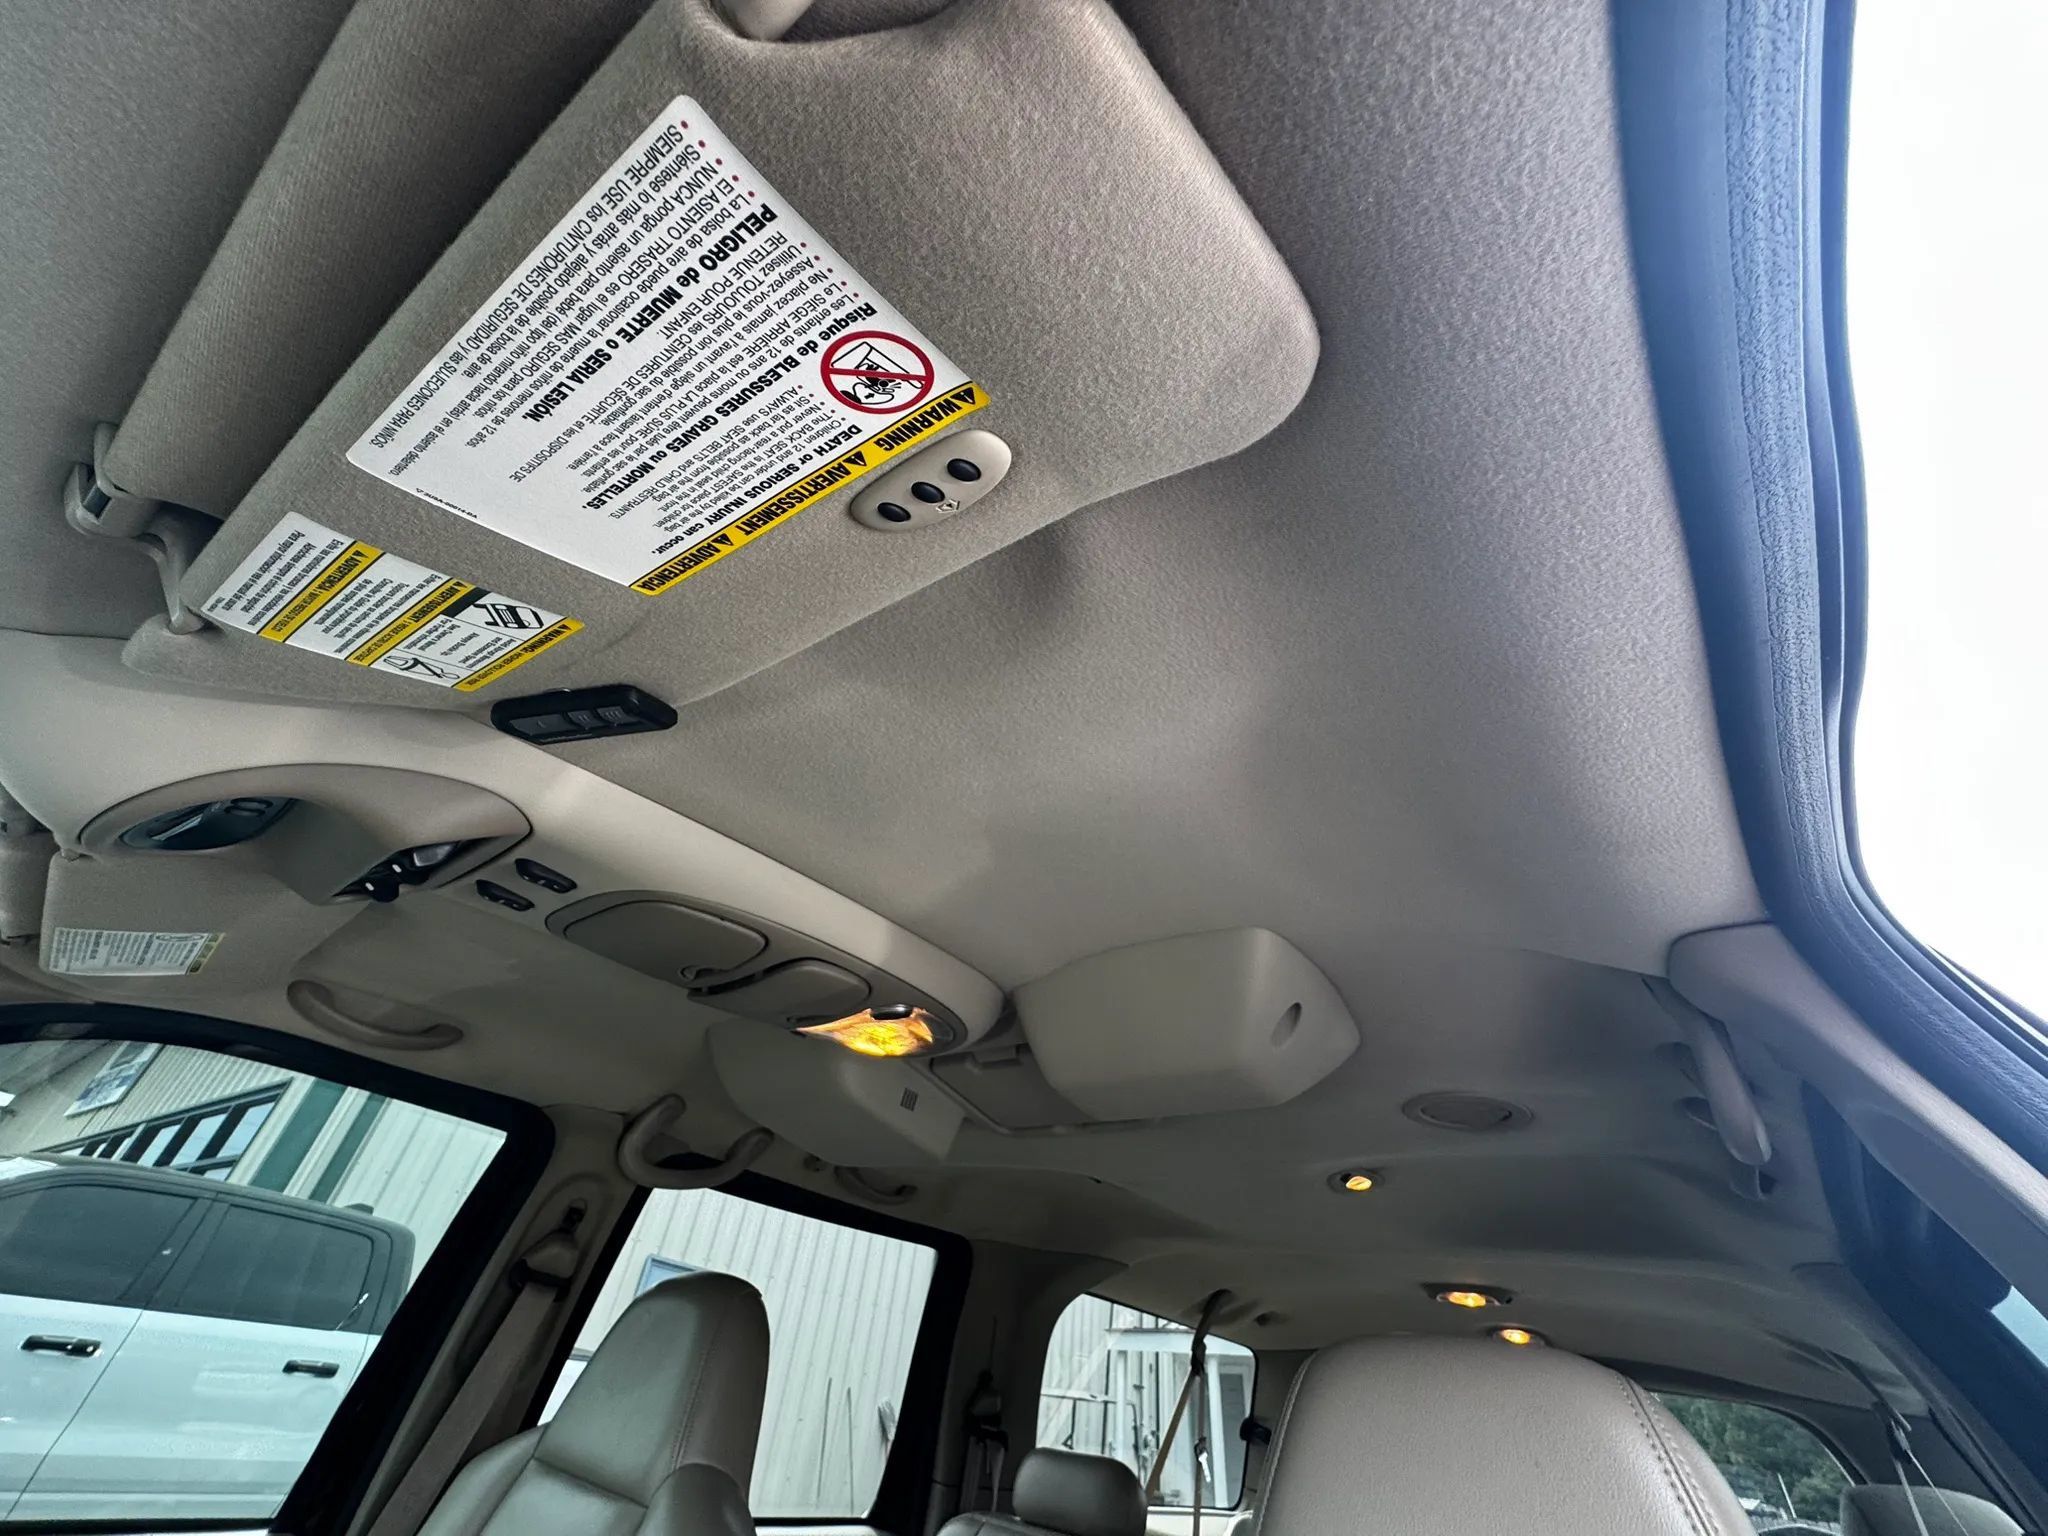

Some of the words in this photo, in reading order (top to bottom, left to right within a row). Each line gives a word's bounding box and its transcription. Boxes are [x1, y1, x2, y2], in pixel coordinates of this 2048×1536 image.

[624, 124, 683, 186] SIEMPRE
[648, 144, 701, 193] Siéntese
[669, 161, 718, 205] NUNCA
[714, 177, 735, 197] El
[600, 178, 632, 210] USE
[637, 188, 656, 204] lo
[728, 193, 750, 210] La
[585, 202, 609, 222] los
[615, 199, 642, 225] más
[639, 196, 675, 232] ponga
[666, 188, 720, 240] ASIENTO
[699, 207, 735, 236] bolsa
[591, 222, 619, 249] atrás
[626, 229, 645, 245] un
[685, 233, 703, 249] de
[698, 202, 778, 271] PELIGRO
[525, 219, 592, 288] CINTURONES
[582, 242, 597, 258] y
[595, 242, 631, 276] asiento
[665, 246, 688, 266] aire
[727, 230, 788, 280] RETENUE
[553, 253, 589, 287] alejado
[617, 236, 673, 286] TRASERO
[758, 245, 802, 277] Utilisez
[574, 270, 600, 295] para
[636, 261, 670, 293] puede
[675, 266, 700, 287] de
[742, 256, 814, 312] Asseyez-vous
[511, 281, 533, 303] DE
[525, 281, 559, 316] posible
[604, 281, 621, 296] es
[696, 275, 734, 306] POUR
[555, 292, 584, 318] bebé
[594, 293, 608, 307] el
[702, 274, 765, 325] TOUJOURS
[514, 313, 531, 327] de
[574, 301, 603, 325] lugar
[596, 290, 640, 331] ocasionar
[615, 284, 683, 343] MUERTE
[732, 309, 748, 320] le
[465, 297, 519, 350] SEGURIDAD
[505, 323, 523, 335] la
[539, 310, 562, 333] (del
[687, 320, 708, 335] les
[711, 315, 735, 337] plus
[818, 302, 877, 341] Risque
[525, 327, 547, 344] tipo
[554, 321, 582, 345] MAS
[586, 327, 603, 338] la
[694, 334, 717, 350] loin
[457, 341, 472, 355] y
[485, 332, 515, 355] bolsa
[509, 340, 531, 359] niño
[559, 335, 591, 363] muerte
[605, 338, 619, 349] o
[796, 339, 818, 356] de
[448, 350, 468, 365] las
[476, 352, 493, 365] de
[519, 341, 561, 377] SEGURO
[548, 360, 565, 373] de
[565, 348, 612, 384] SERIA
[635, 333, 692, 379] CEINTURES
[660, 345, 698, 378] possible
[482, 356, 515, 385] mirando
[501, 371, 524, 391] para
[528, 370, 554, 391] niños
[406, 361, 457, 411] SUJECIONES
[464, 382, 492, 402] hacia
[621, 375, 641, 391] DE
[634, 385, 652, 399] sac
[648, 376, 664, 387] du
[714, 354, 801, 417] BLESSURES
[491, 388, 511, 401] los
[500, 388, 534, 417] menores
[521, 381, 575, 422] LESIÓN.
[758, 386, 798, 416] ALWAYS
[445, 399, 471, 420] atrás)
[580, 387, 630, 424] SÉCURITÉ
[792, 403, 822, 424] Never
[388, 406, 415, 428] PARA
[439, 417, 453, 427] en
[490, 415, 505, 425] de
[572, 420, 585, 430] et
[742, 413, 760, 426] use
[776, 419, 793, 434] put
[873, 397, 962, 451] WARNING
[432, 425, 445, 435] el
[481, 424, 497, 435] 12
[562, 426, 580, 438] les
[665, 414, 718, 452] GRAVES
[719, 424, 745, 444] SEAT
[803, 419, 842, 444] Children
[812, 424, 862, 456] DEATH
[413, 430, 439, 452] asiento
[692, 440, 723, 462] BELTS
[726, 435, 772, 465] rear-facing
[791, 442, 805, 452] 12
[519, 435, 569, 474] DISPOSITIFS
[648, 450, 667, 463] ou
[677, 458, 695, 472] and
[775, 449, 793, 463] and
[798, 453, 813, 465] or
[508, 470, 526, 482] DE
[710, 462, 731, 478] child
[753, 459, 778, 476] under
[582, 461, 655, 509] MORTELLES.
[654, 469, 682, 488] CHILD
[686, 485, 699, 493] in
[694, 475, 713, 489] seat
[728, 483, 743, 492] be
[738, 474, 755, 485] can
[743, 463, 800, 499] SERIOUS
[675, 491, 691, 501] the
[698, 502, 714, 511] by
[708, 490, 732, 505] killed
[734, 461, 852, 536] AVERTISSEMENT
[679, 516, 691, 524] air
[688, 508, 704, 518] the
[704, 496, 748, 525] INJURY
[682, 522, 704, 536] can
[651, 535, 684, 554] occur.
[315, 555, 362, 591] ADVERTENCIA
[636, 542, 721, 591] ADVERTENCIA
[407, 585, 461, 623] AVERTISSEMENT
